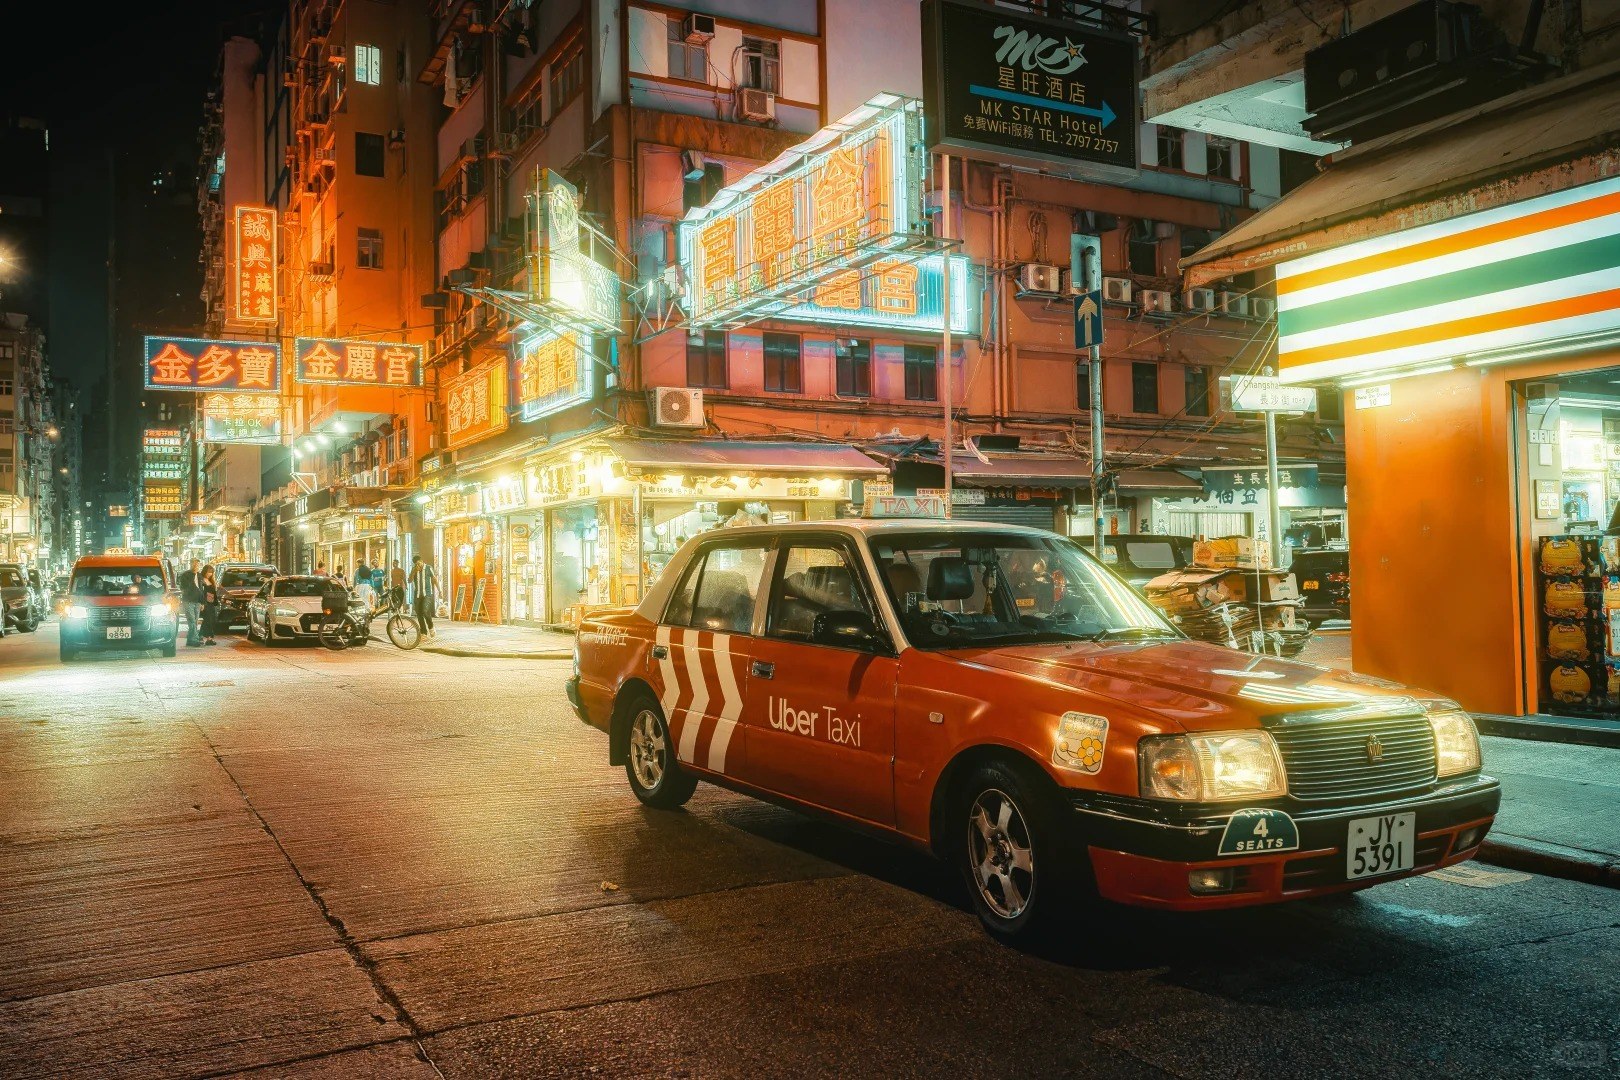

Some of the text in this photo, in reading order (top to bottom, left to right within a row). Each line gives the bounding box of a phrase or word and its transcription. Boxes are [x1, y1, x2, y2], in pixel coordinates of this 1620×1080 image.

[997, 67, 1086, 105] 星旺酒店
[980, 100, 1103, 135] MK STAR Hotel
[1065, 133, 1091, 148] 2797
[1093, 138, 1119, 153] 2757
[149, 343, 276, 388] 金多寶
[302, 343, 416, 385] 金麗宮
[207, 394, 280, 417] 金多寶
[222, 417, 262, 427] 卡拉OK
[880, 497, 940, 517] TAXI
[768, 695, 861, 747] Uber Taxi
[1253, 817, 1269, 838] 4
[1369, 816, 1396, 846] JY
[1236, 838, 1284, 851] SEATS
[1353, 841, 1402, 875] 5391
